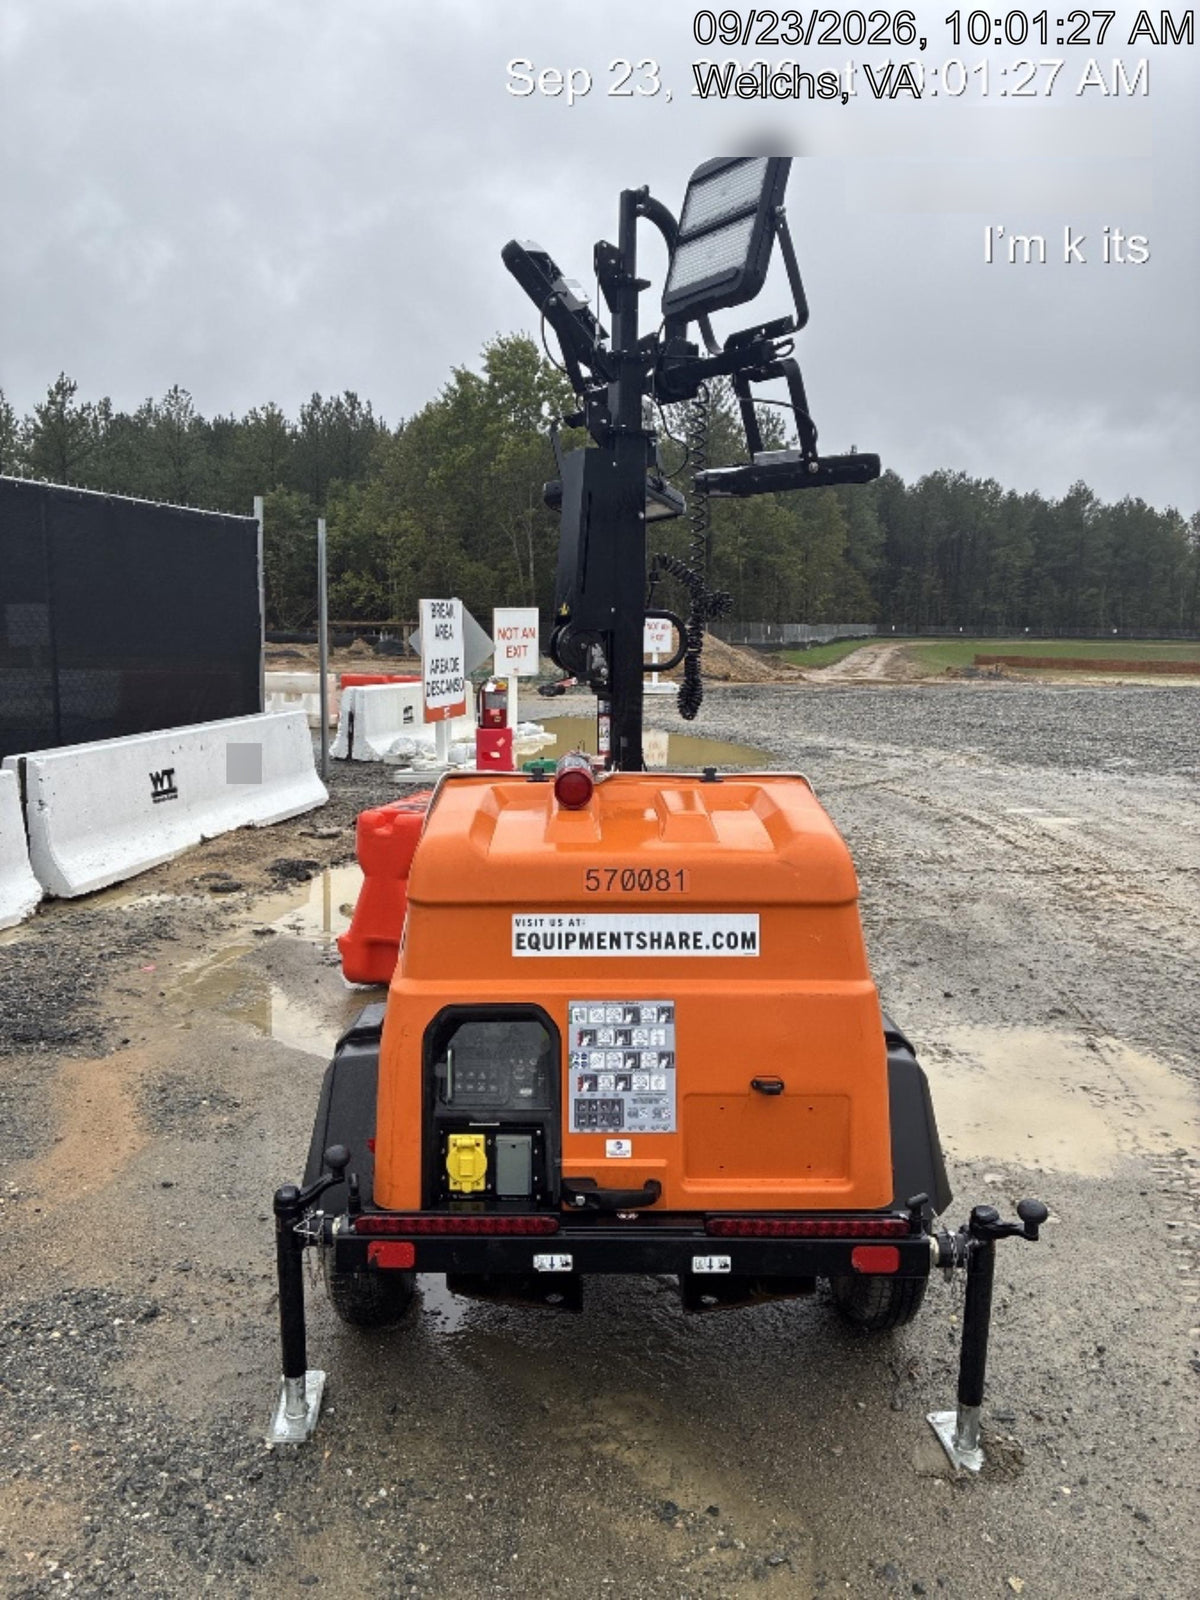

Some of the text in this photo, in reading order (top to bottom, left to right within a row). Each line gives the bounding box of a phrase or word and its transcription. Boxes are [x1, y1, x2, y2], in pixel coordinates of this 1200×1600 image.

[498, 627, 536, 640] NOT AN
[506, 645, 528, 658] EXIT
[585, 868, 684, 892] 570081
[515, 918, 544, 927] VISIT
[549, 918, 563, 927] US
[515, 931, 757, 951] EQUIPMENTSHARE.COM
